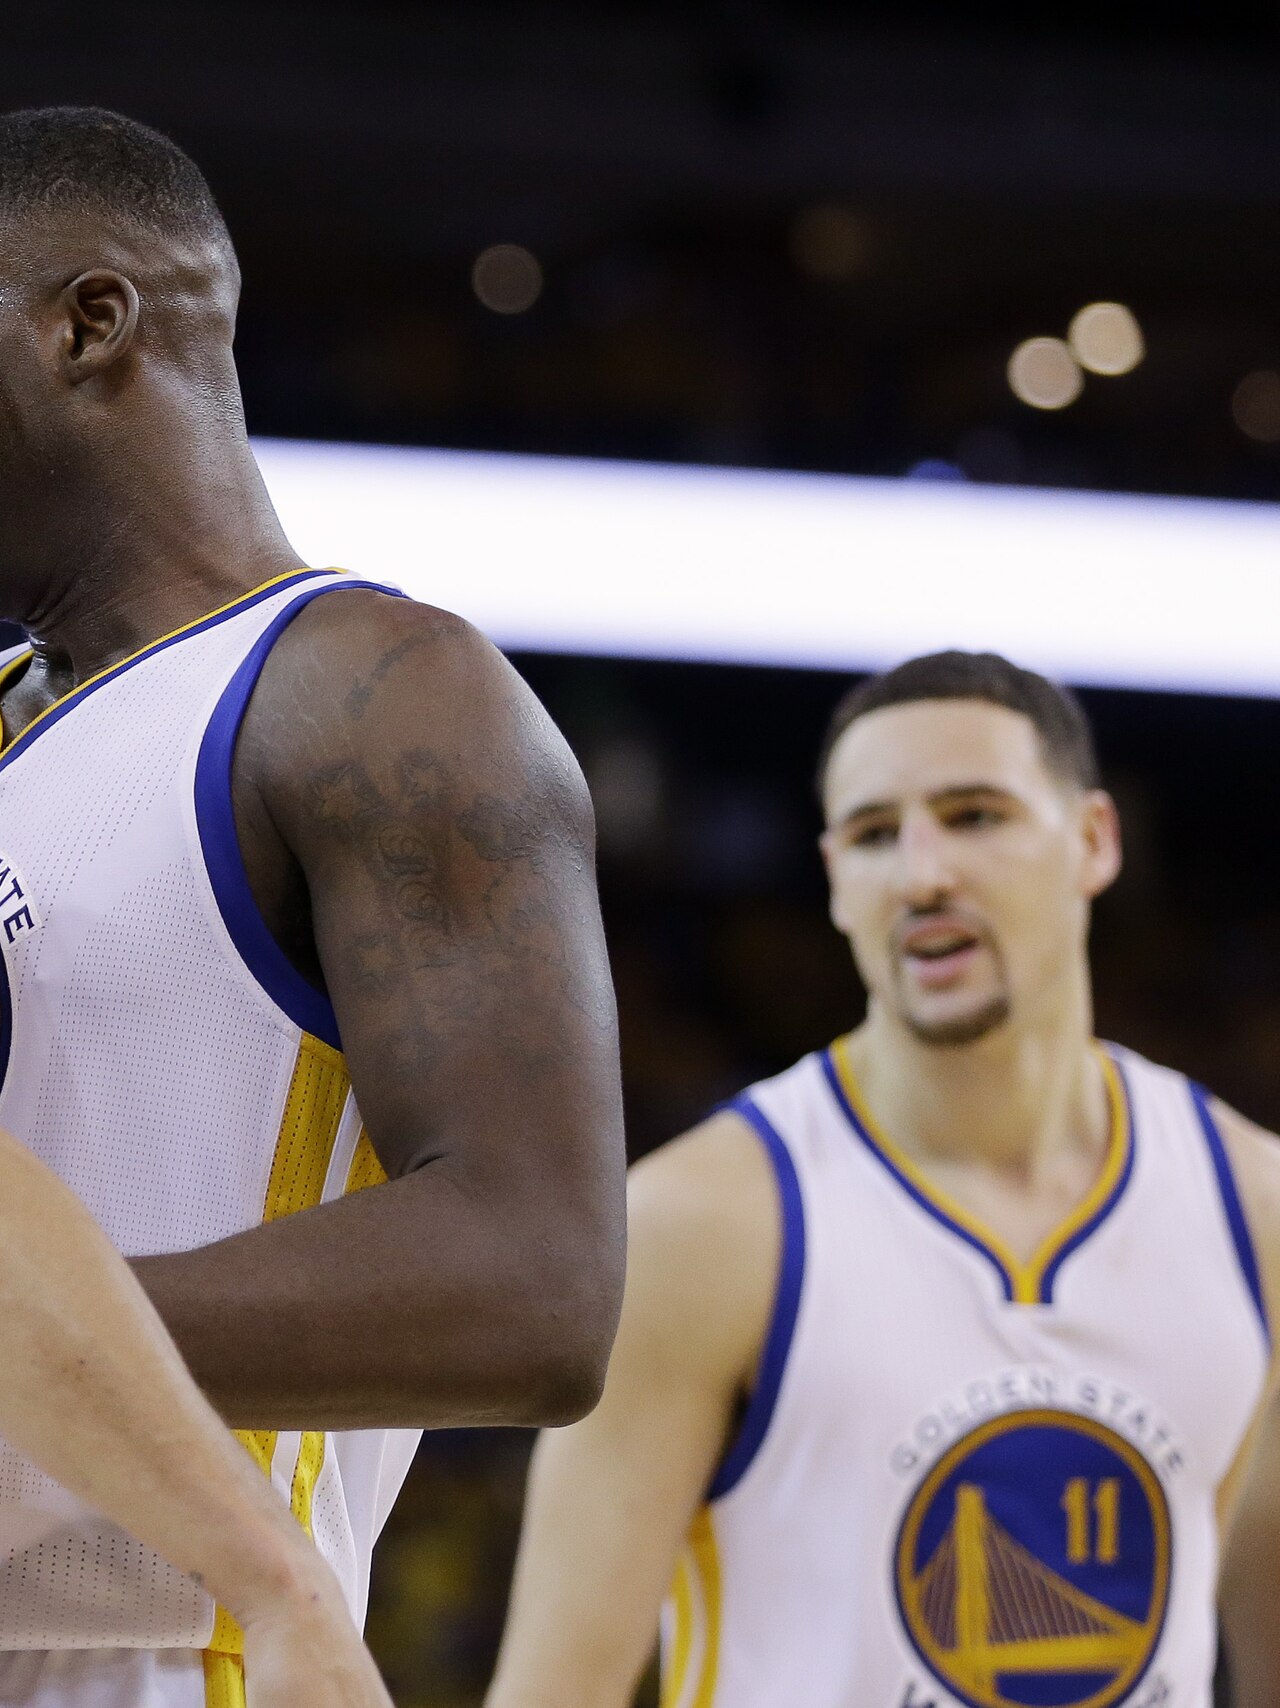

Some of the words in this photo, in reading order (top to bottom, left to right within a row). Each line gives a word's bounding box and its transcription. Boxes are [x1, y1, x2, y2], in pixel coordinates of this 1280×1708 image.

[888, 1367, 1057, 1477] GOLDEN
[1076, 1381, 1185, 1475] STATE
[1059, 1476, 1120, 1567] 11
